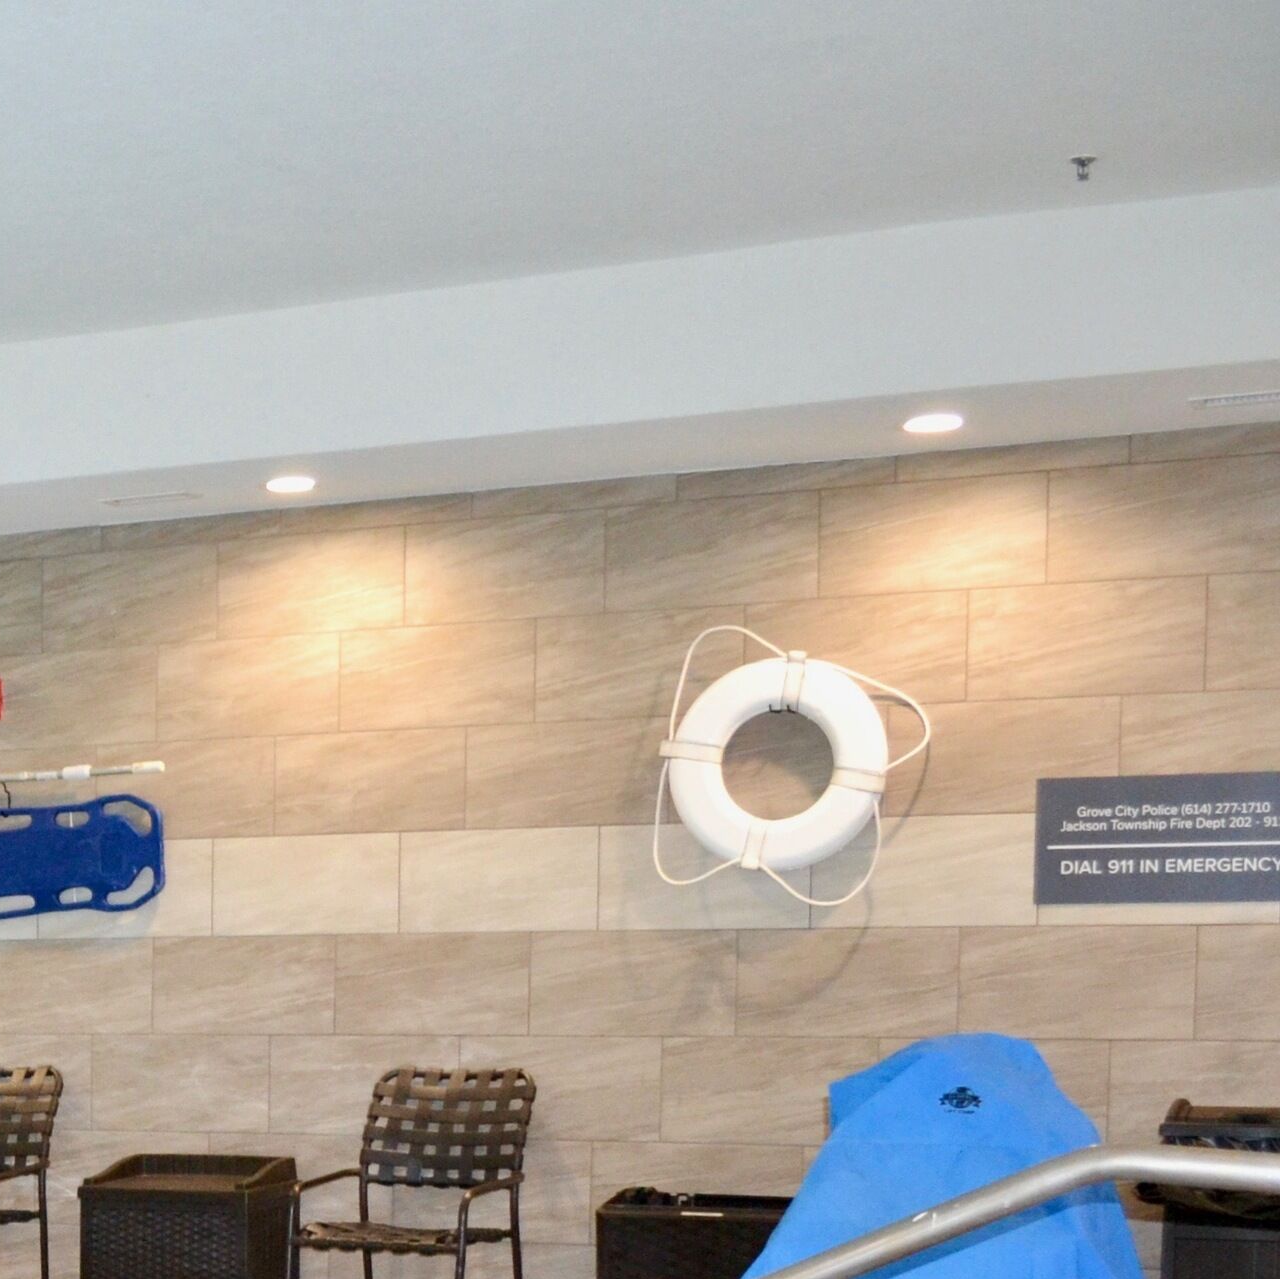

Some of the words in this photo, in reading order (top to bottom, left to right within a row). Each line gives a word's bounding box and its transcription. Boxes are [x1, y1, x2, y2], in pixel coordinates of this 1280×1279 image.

[1076, 805, 1113, 818] Grove
[1114, 803, 1140, 820] City
[1141, 804, 1179, 816] Police
[1180, 802, 1213, 817] (614)
[1214, 801, 1272, 815] 277-1710
[1060, 820, 1108, 832] Jackson
[1110, 817, 1168, 832] Township
[1169, 817, 1193, 830] Fire
[1195, 816, 1227, 831] Dept
[1228, 815, 1253, 829] 202
[1060, 859, 1103, 875] DIAL
[1107, 858, 1135, 875] 911
[1139, 858, 1160, 874] IN
[1164, 856, 1280, 873] EMERGENCY
